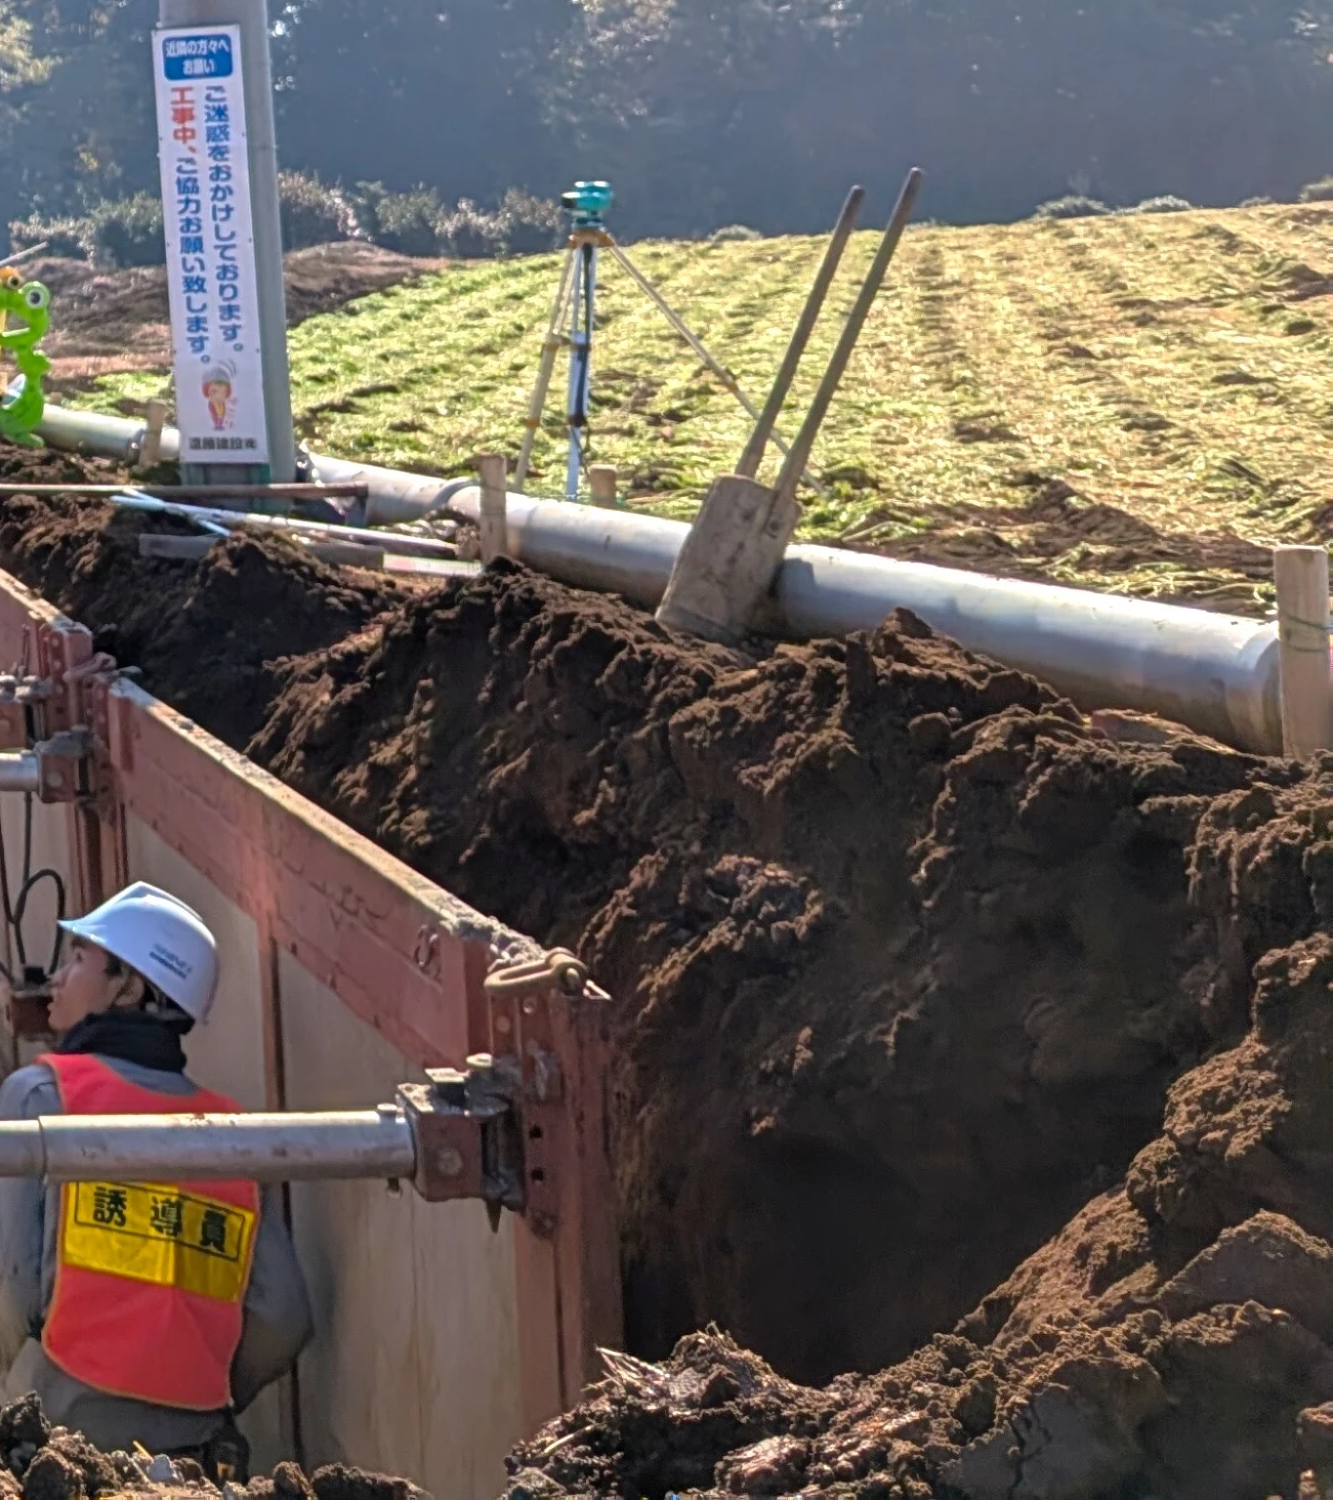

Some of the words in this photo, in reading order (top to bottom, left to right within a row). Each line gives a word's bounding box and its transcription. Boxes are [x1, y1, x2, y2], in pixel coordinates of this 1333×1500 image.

[165, 38, 230, 58] 近隣の方々へ
[182, 57, 216, 76] お願い
[204, 84, 244, 352] ご迷惑をおかけしております。
[92, 1185, 227, 1253] 誘導員
